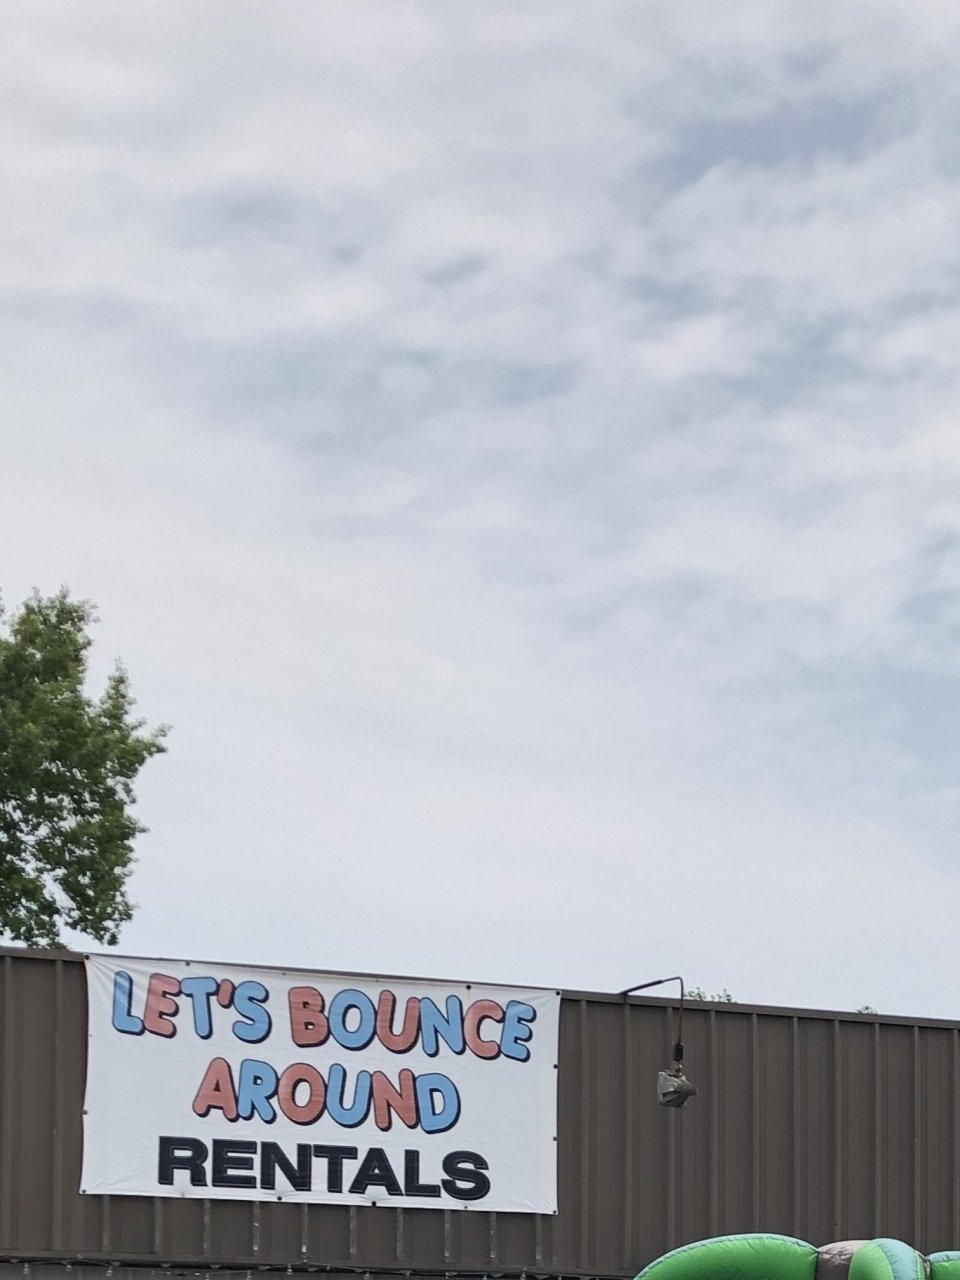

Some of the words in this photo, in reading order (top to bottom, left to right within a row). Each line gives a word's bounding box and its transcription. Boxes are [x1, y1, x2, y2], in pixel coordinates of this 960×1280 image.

[111, 970, 273, 1043] LET'S
[288, 985, 537, 1062] BOUNCE
[192, 1057, 461, 1134] AROUND
[157, 1135, 491, 1200] RENTALS
